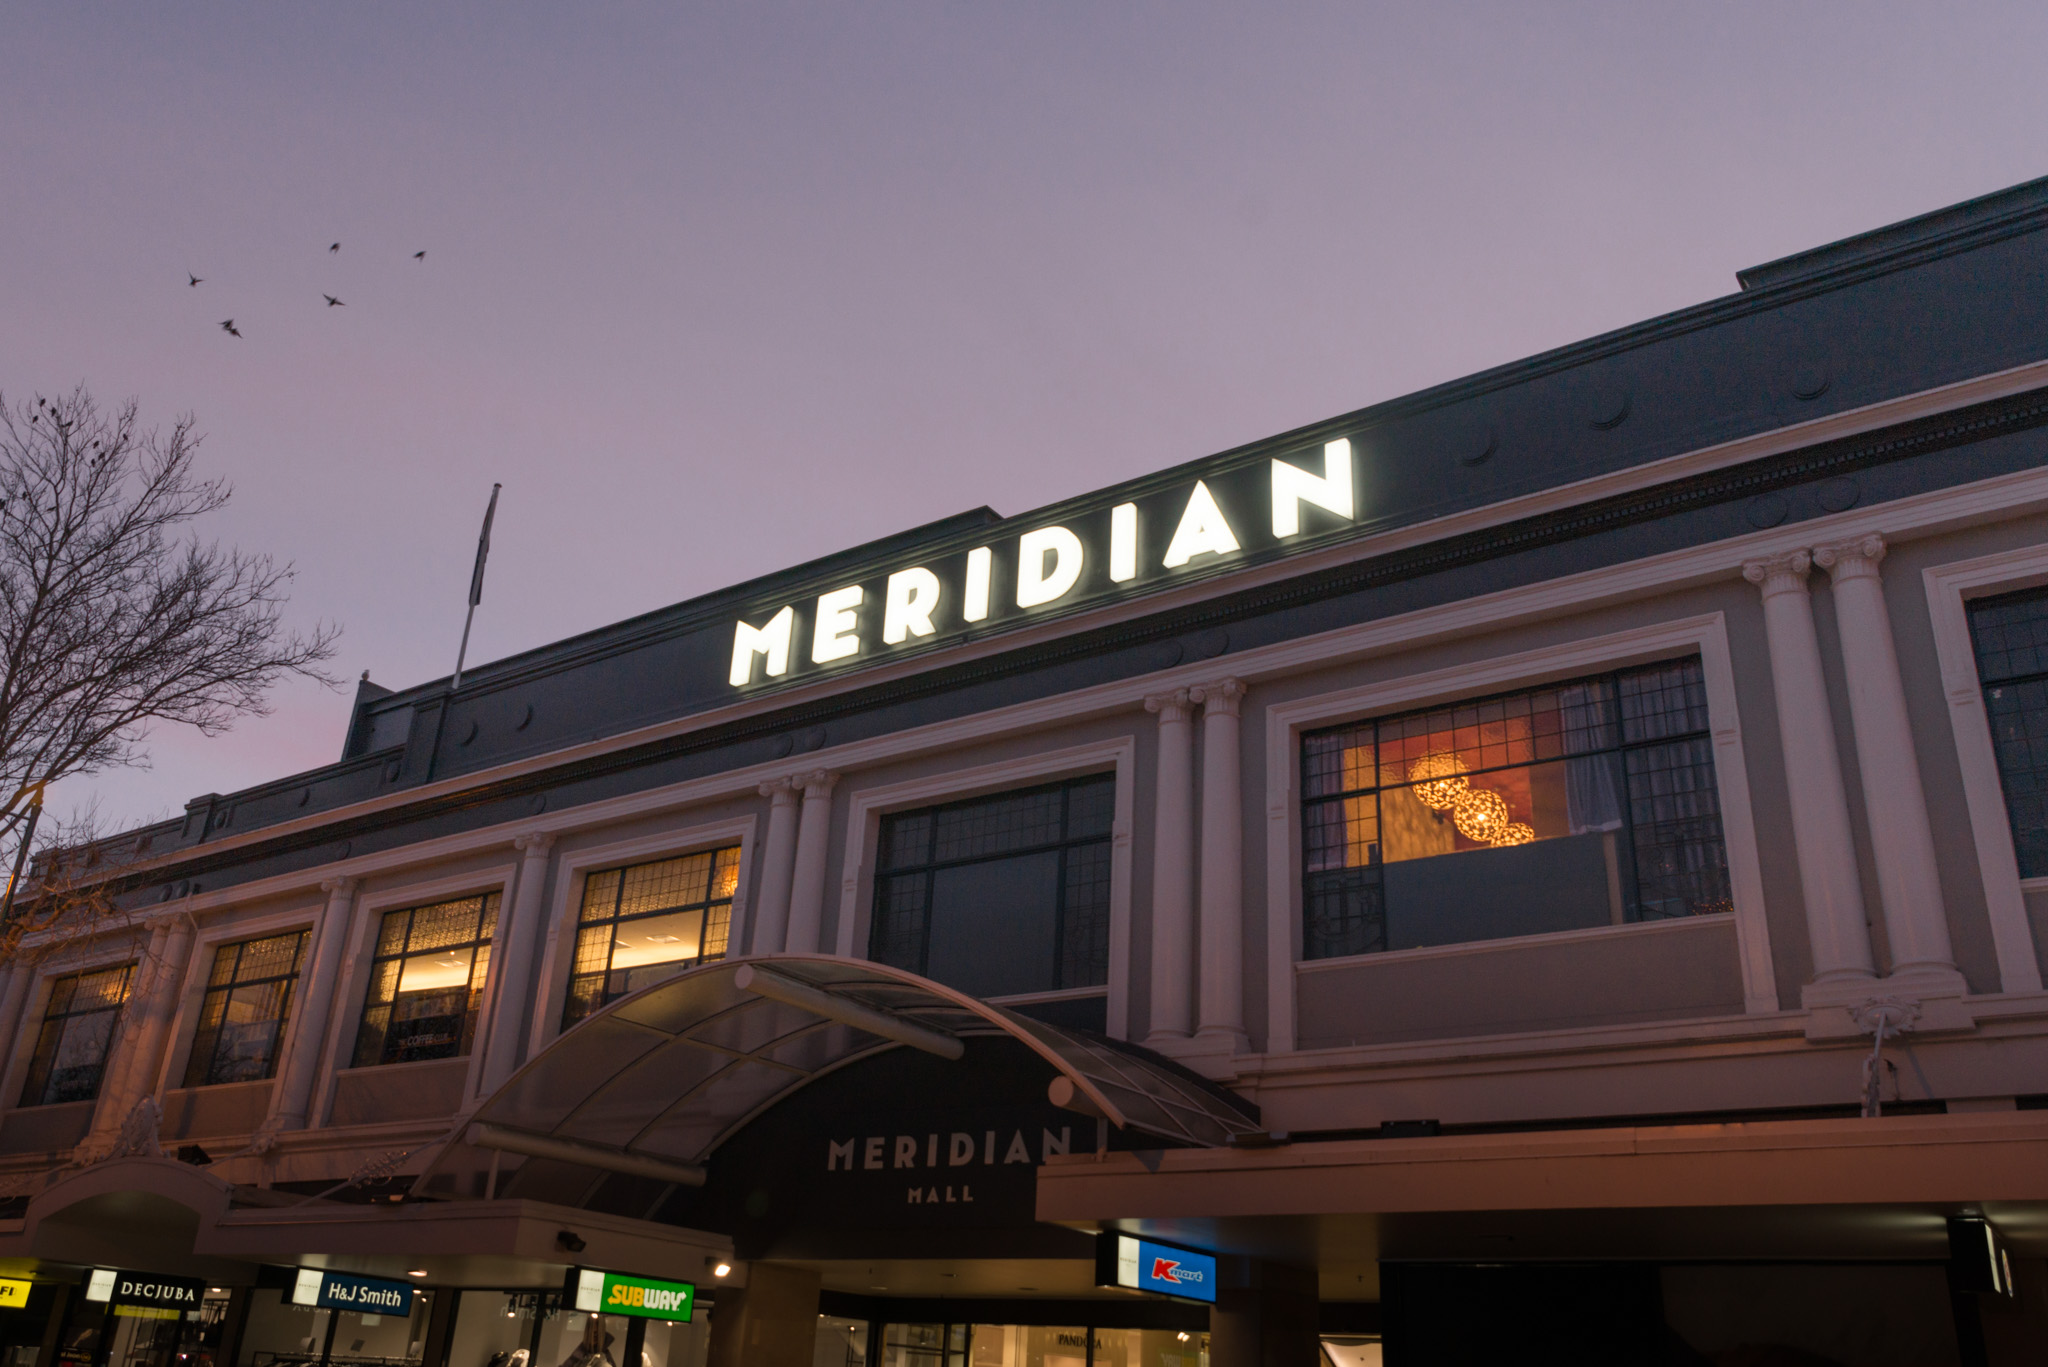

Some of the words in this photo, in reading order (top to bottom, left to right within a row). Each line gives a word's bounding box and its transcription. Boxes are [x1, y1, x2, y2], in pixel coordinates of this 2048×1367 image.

[728, 437, 1354, 687] MERIDIAN
[827, 1126, 1071, 1171] MERIDIAN
[907, 1185, 974, 1203] MALL
[1152, 1257, 1203, 1284] Kmart
[120, 1281, 195, 1301] DECJUBA
[328, 1282, 358, 1301] H&J
[358, 1286, 401, 1307] Smith
[607, 1284, 687, 1311] SUBWAY
[1059, 1334, 1102, 1350] PANDOA
